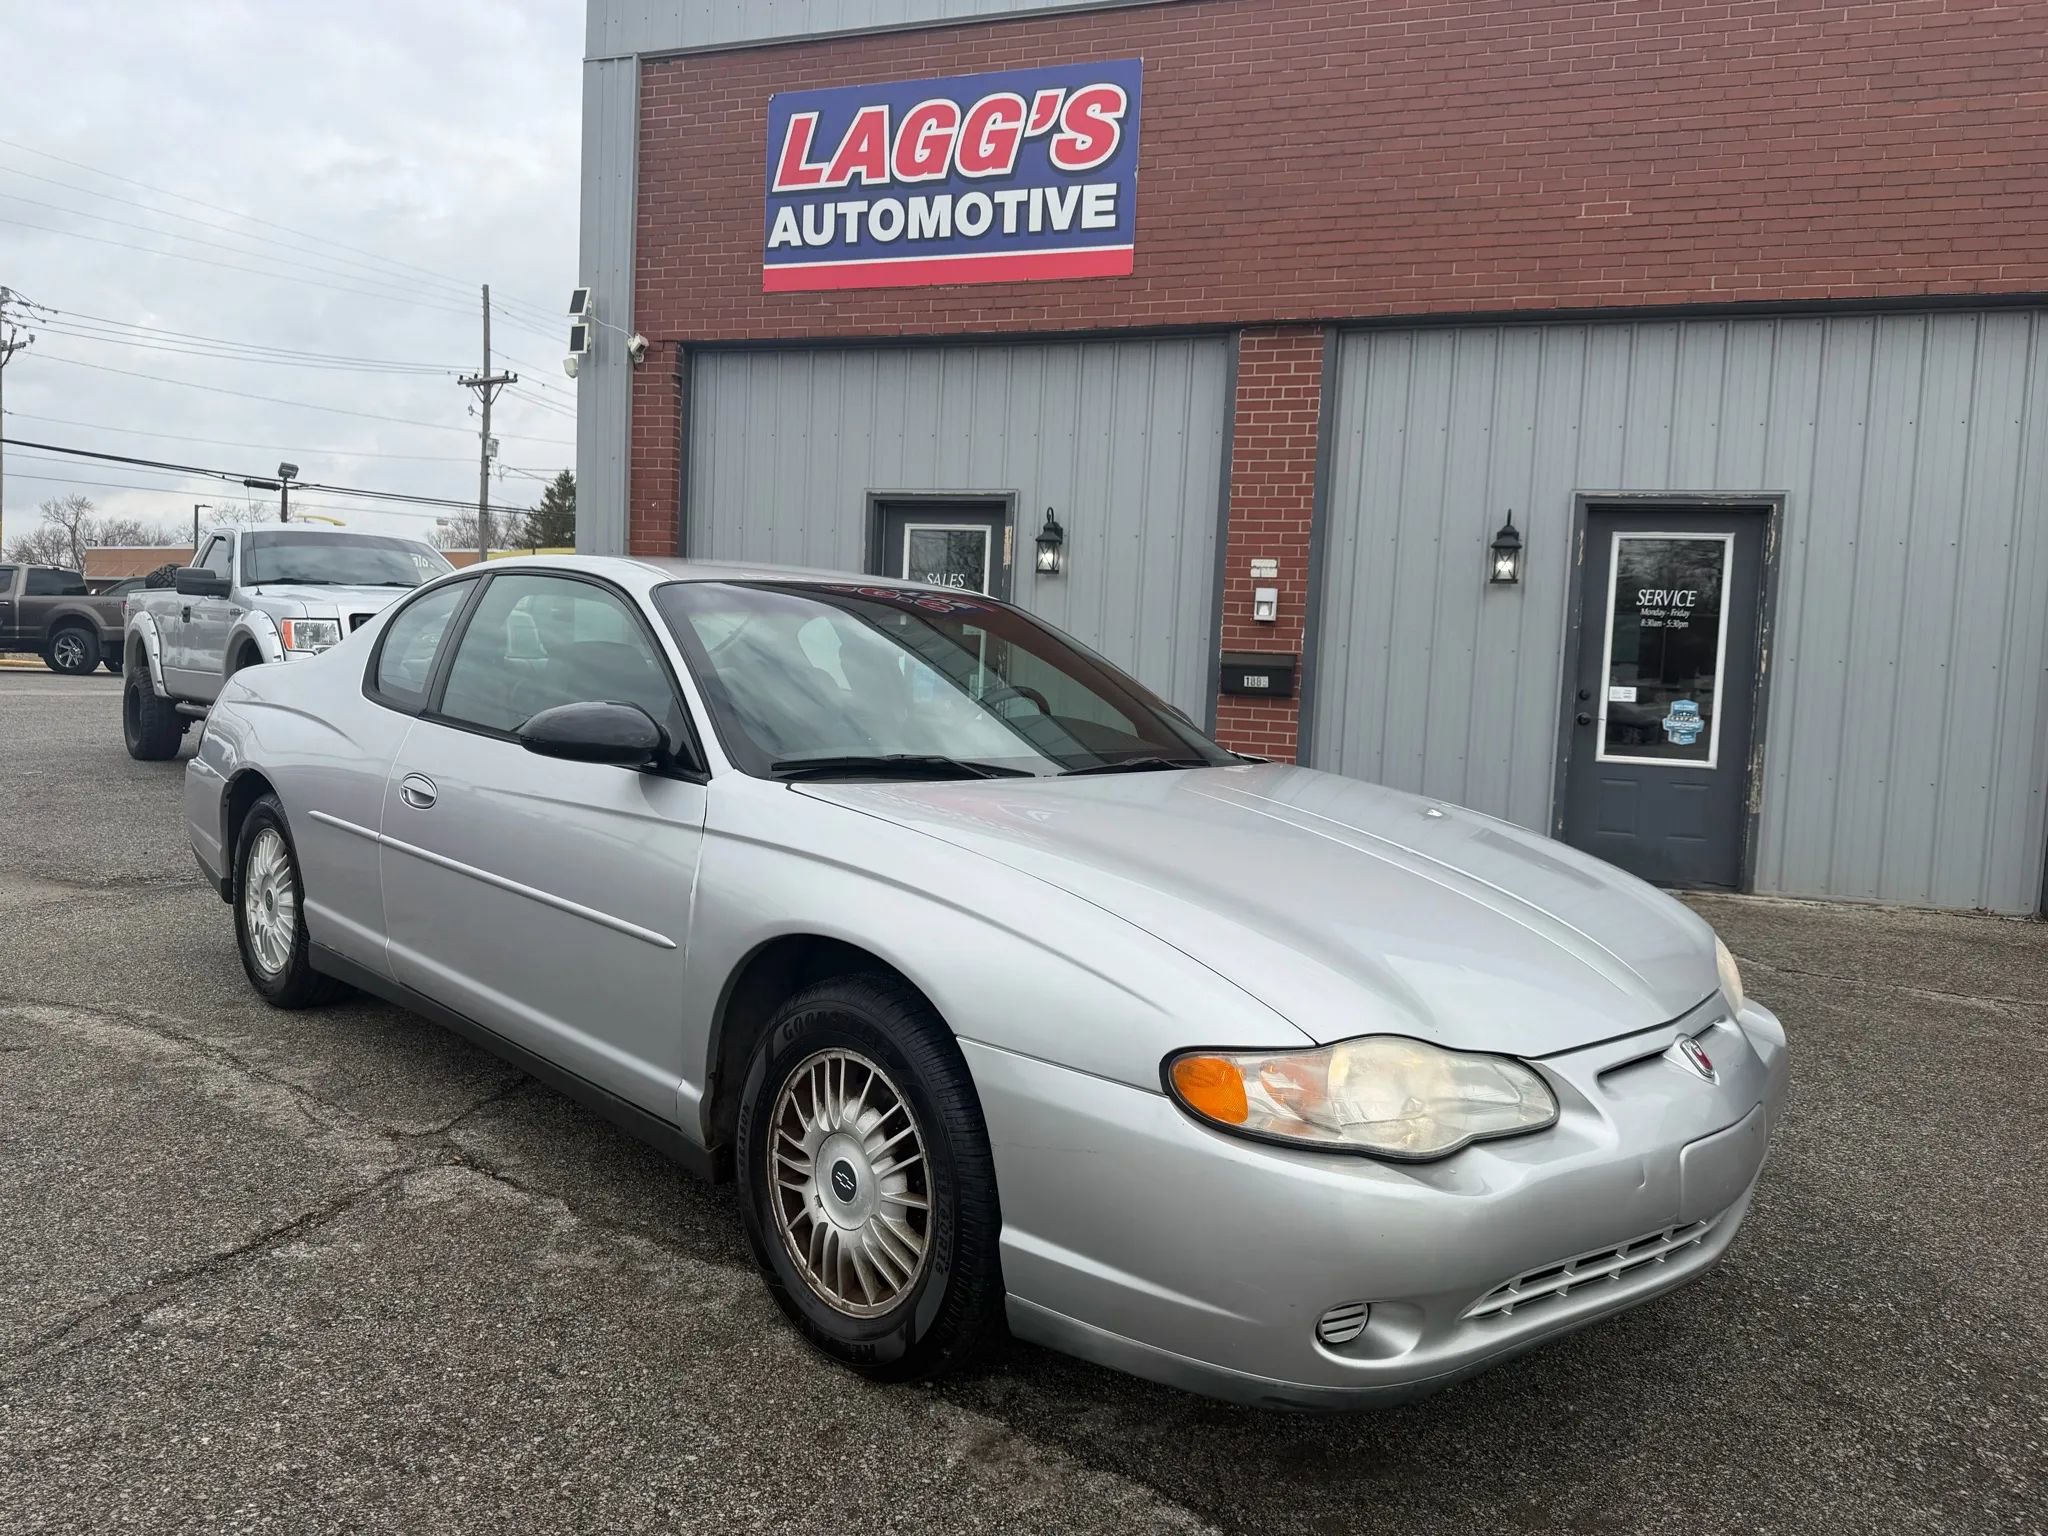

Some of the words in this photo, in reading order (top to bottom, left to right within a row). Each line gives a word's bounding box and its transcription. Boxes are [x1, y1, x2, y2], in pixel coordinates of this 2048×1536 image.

[771, 82, 1128, 193] LAGG'S
[767, 182, 1118, 249] AUTOMOTIVE
[927, 572, 965, 588] SALES
[1636, 588, 1698, 607] SERVICE
[1640, 607, 1667, 618] Monday
[1670, 608, 1691, 619] Friday
